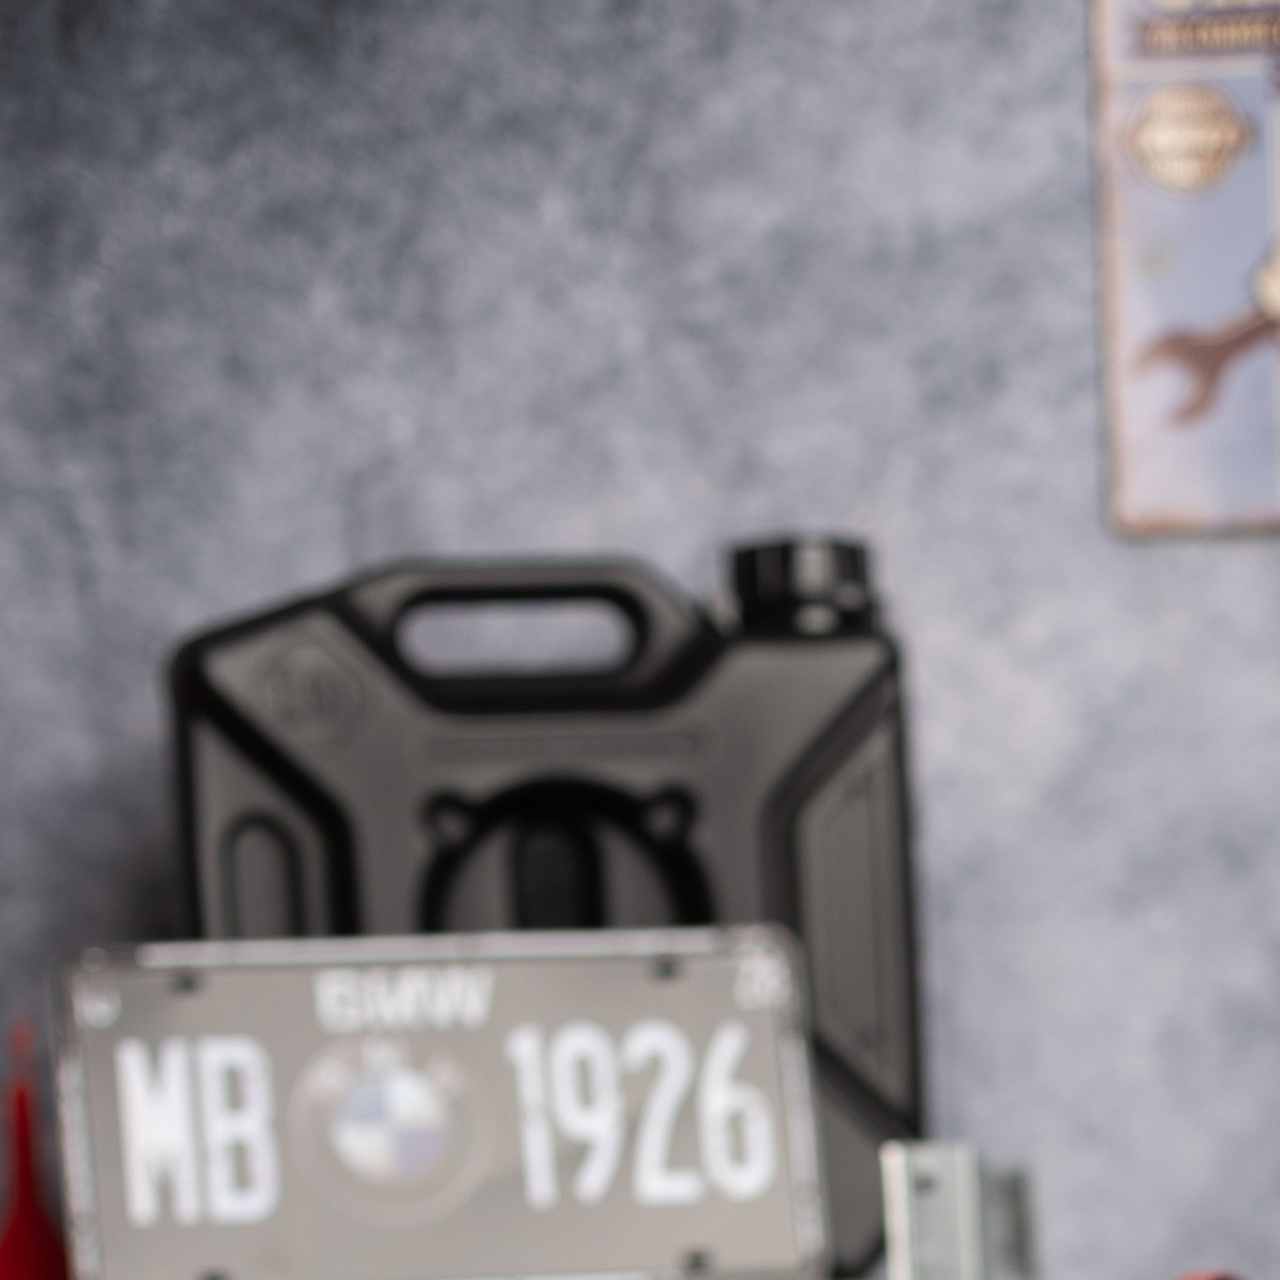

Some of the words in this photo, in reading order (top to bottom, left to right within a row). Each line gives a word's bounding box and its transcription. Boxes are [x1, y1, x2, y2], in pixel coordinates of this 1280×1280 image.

[313, 966, 497, 1034] BMW
[113, 1034, 281, 1228] MB
[503, 1018, 776, 1210] 1926
